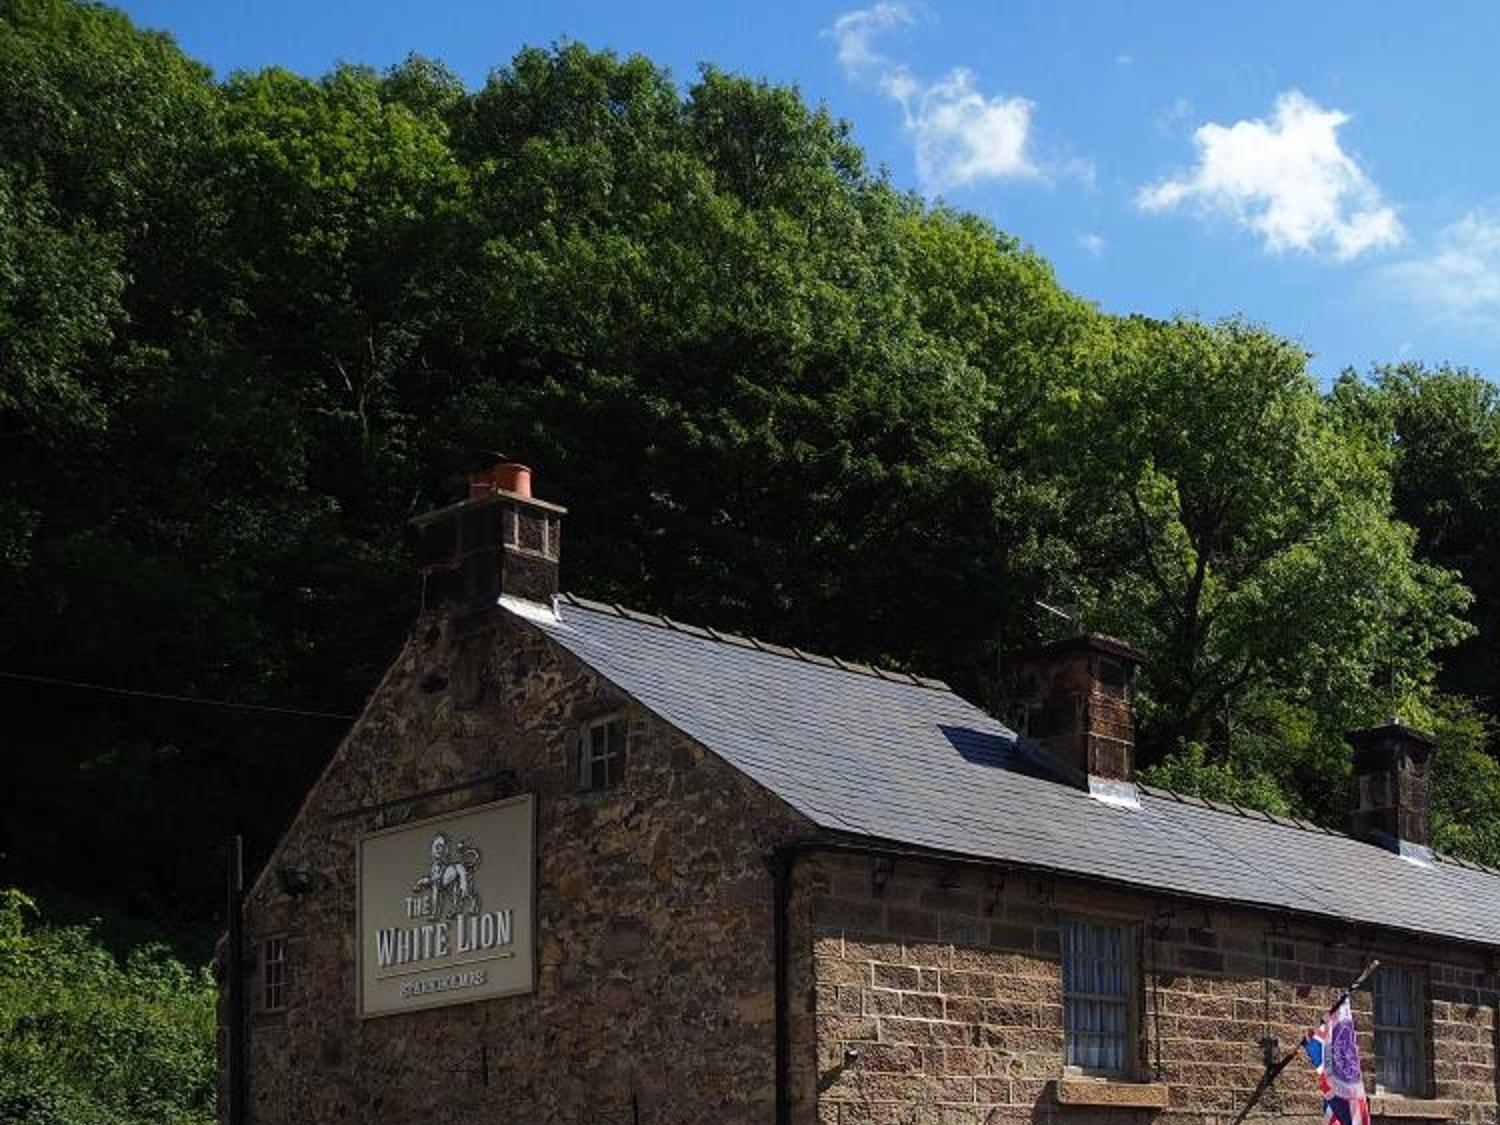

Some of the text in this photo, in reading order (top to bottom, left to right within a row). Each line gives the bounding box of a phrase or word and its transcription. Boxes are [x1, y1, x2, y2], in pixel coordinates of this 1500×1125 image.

[405, 896, 432, 917] THE
[376, 909, 513, 968] WHITE LION
